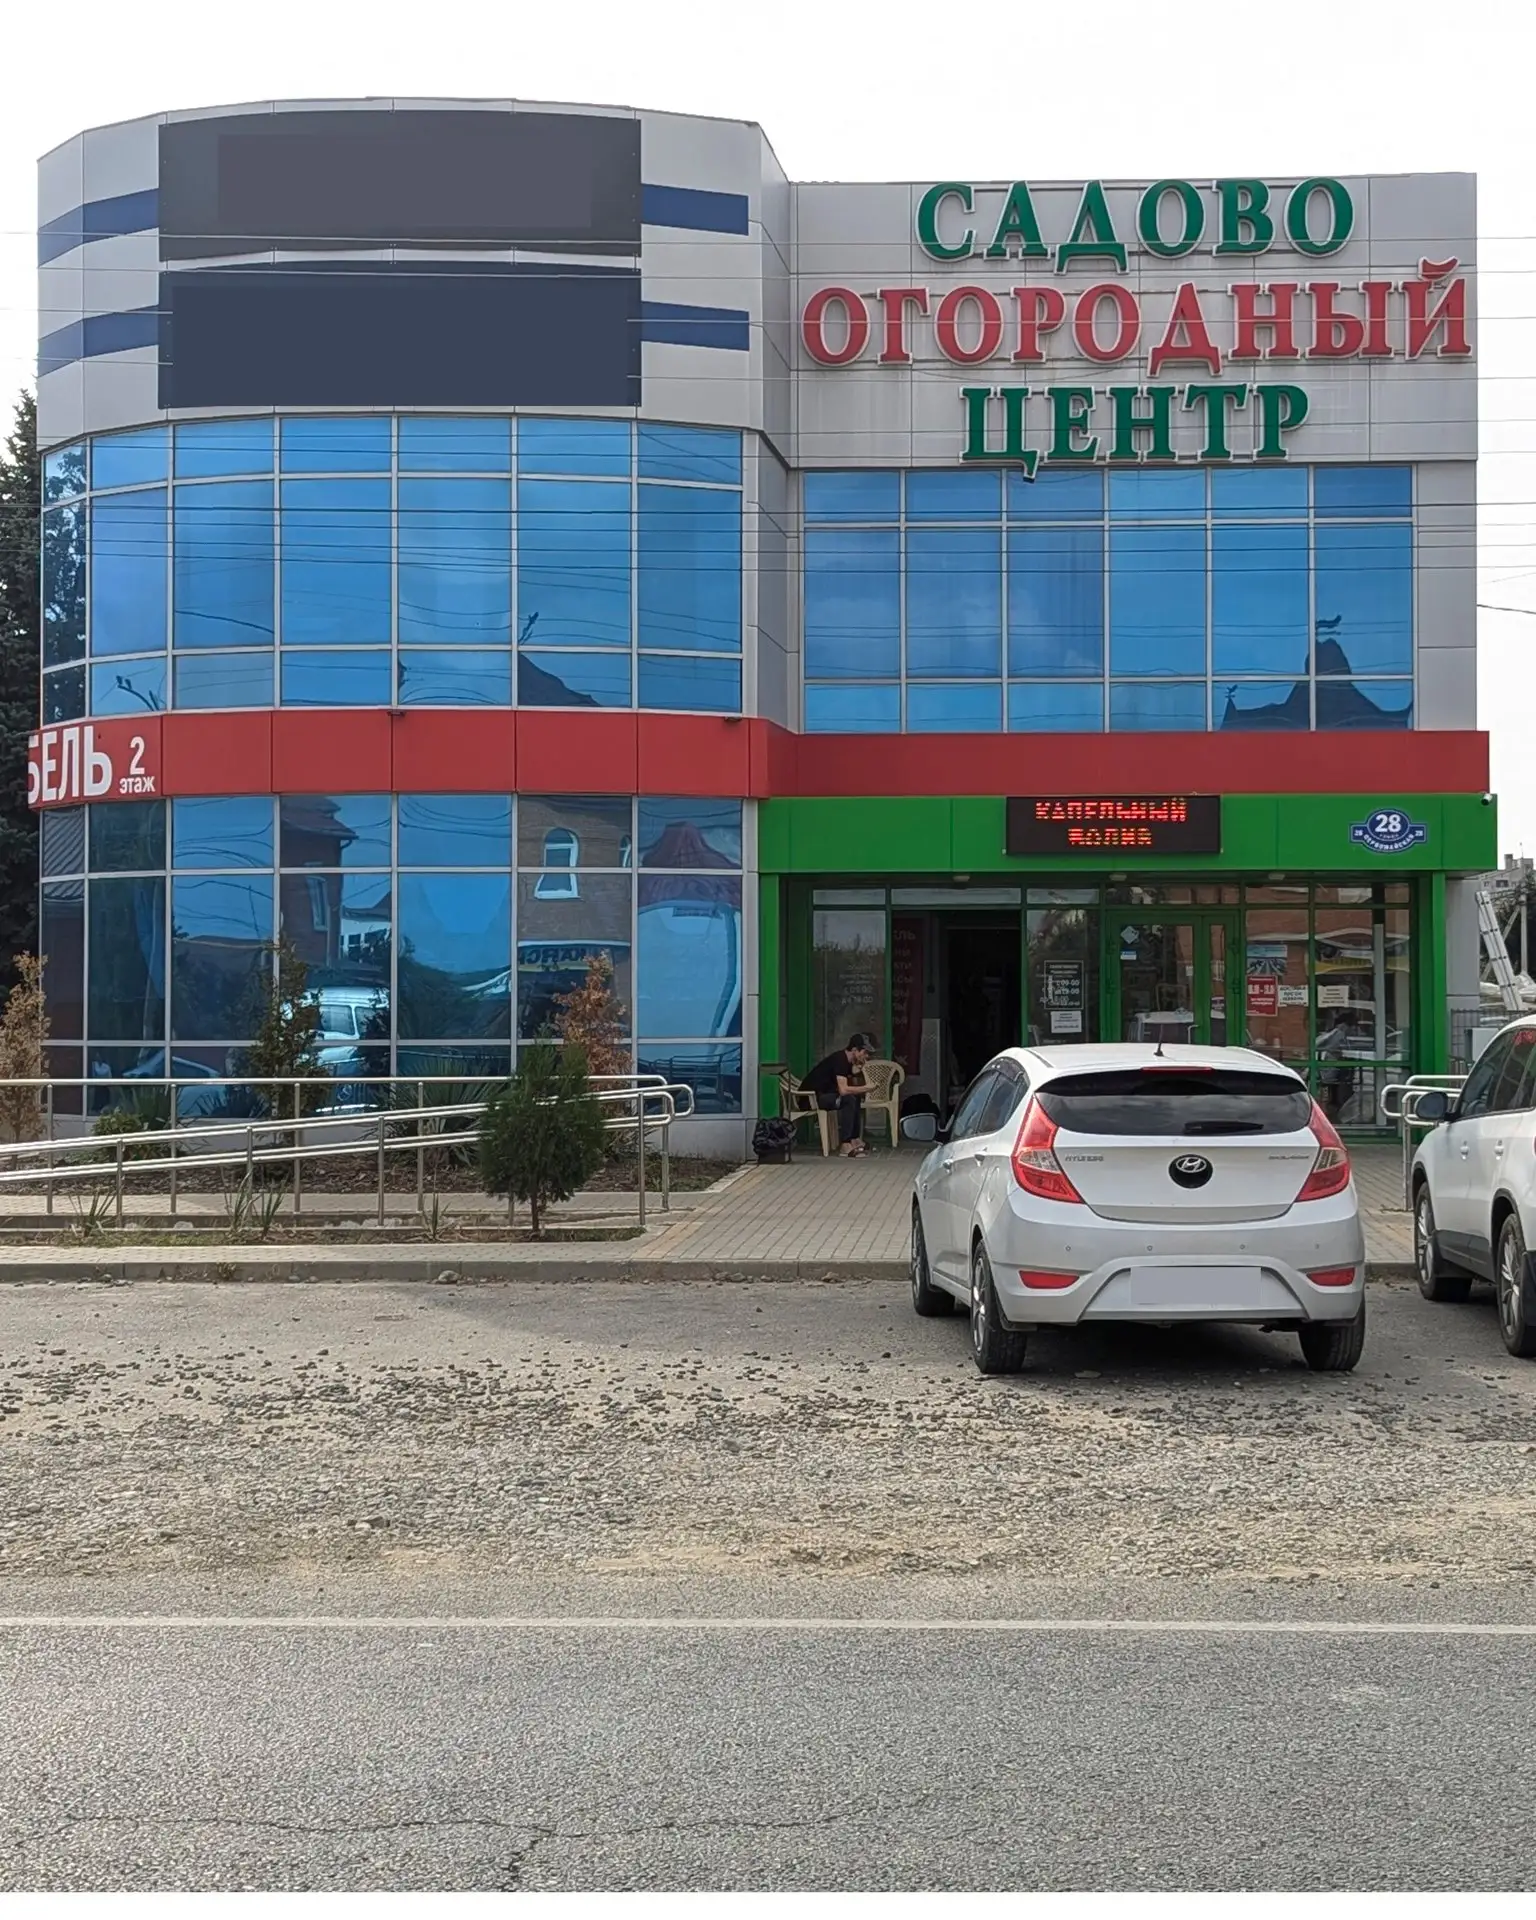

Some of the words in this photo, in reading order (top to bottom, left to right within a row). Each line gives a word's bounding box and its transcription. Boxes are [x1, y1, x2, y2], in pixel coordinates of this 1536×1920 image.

[914, 176, 1355, 275] САДОВО
[800, 256, 1474, 377] ОГОРОДНЫЙ
[959, 382, 1310, 483] ЦЕНТР
[119, 776, 156, 794] этаж
[130, 736, 145, 775] 2
[1375, 814, 1402, 832] 28
